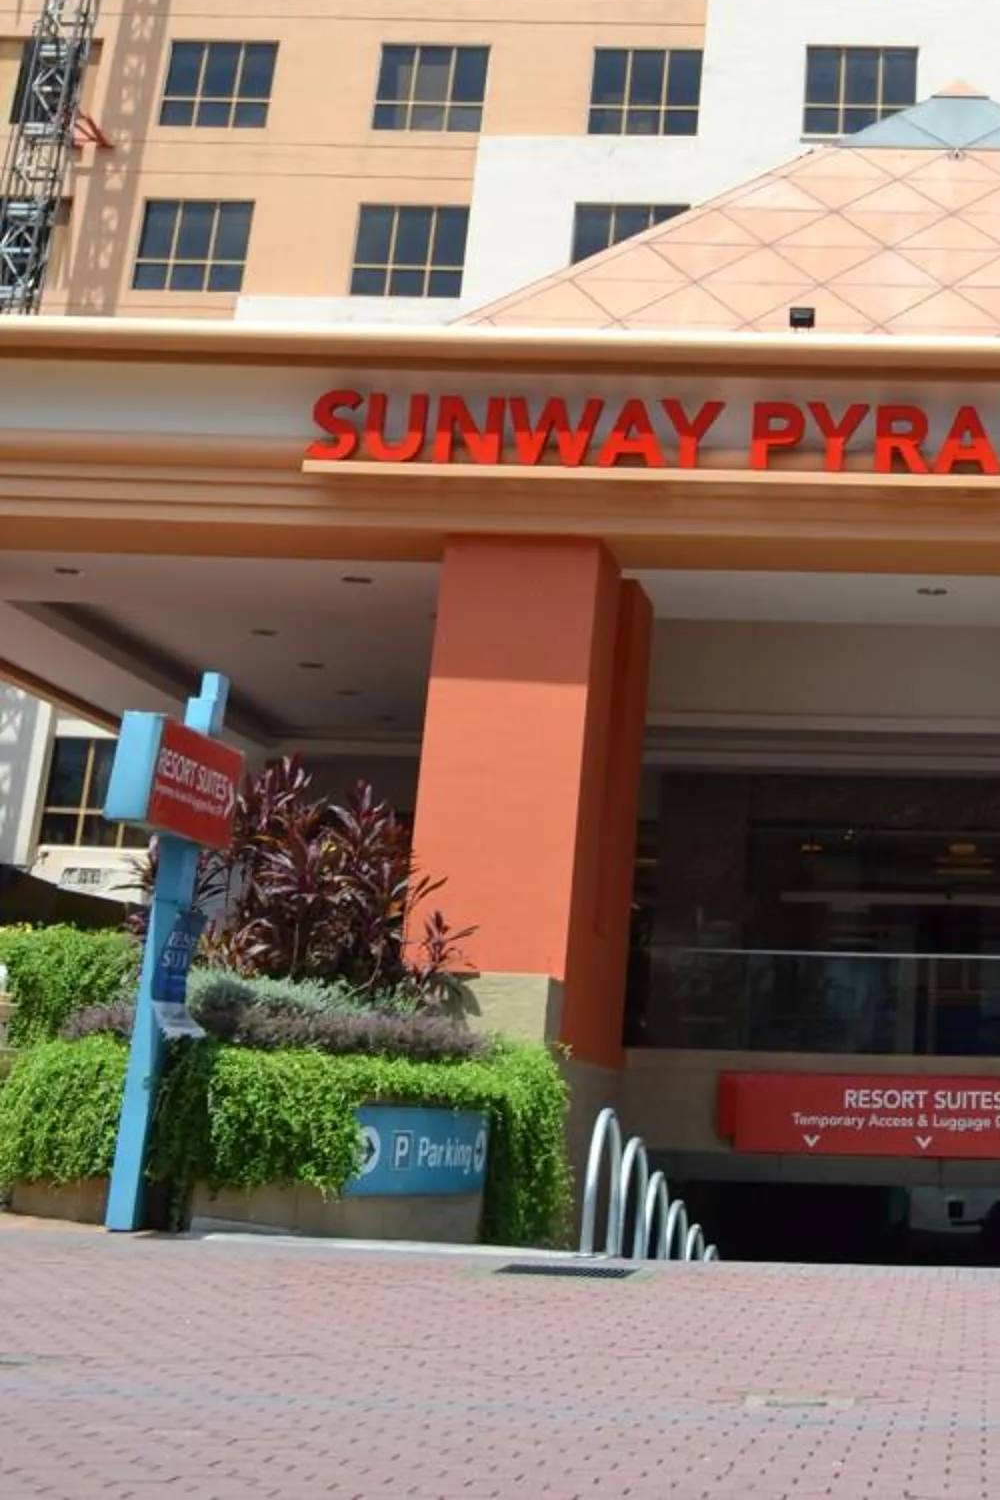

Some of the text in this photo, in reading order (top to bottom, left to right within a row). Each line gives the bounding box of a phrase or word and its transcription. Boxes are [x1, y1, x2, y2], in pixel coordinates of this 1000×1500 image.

[305, 389, 725, 468] SUNWAY
[157, 748, 198, 788] RESORT
[196, 765, 228, 801] SUITES
[844, 1088, 929, 1109] RESORT
[791, 1111, 866, 1131] Temporary
[868, 1113, 914, 1128] Access
[916, 1113, 929, 1128] &
[932, 1114, 992, 1132] Luggage
[417, 1136, 473, 1175] Parking
